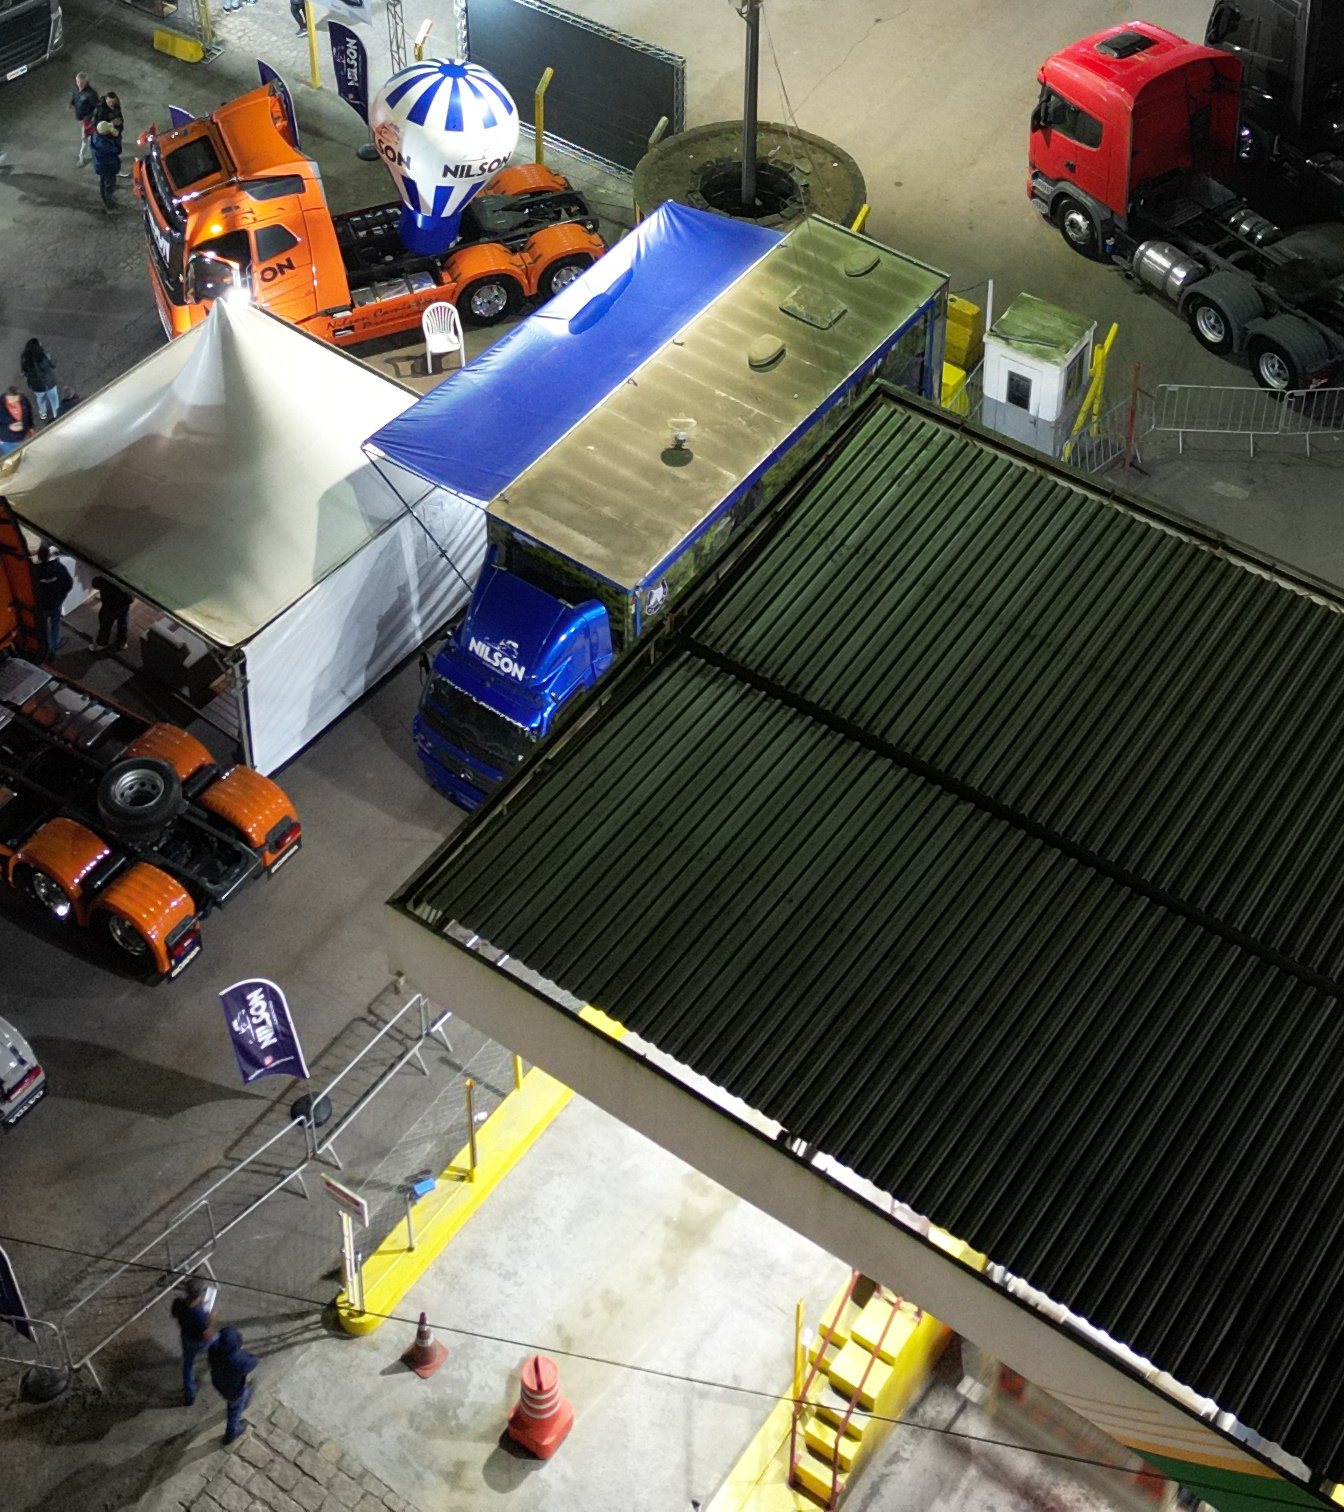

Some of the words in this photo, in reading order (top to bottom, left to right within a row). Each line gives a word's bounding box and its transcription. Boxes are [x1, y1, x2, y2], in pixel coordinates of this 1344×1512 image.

[442, 152, 512, 179] NILSON
[468, 636, 527, 682] NILSON
[246, 988, 278, 1050] NILSON
